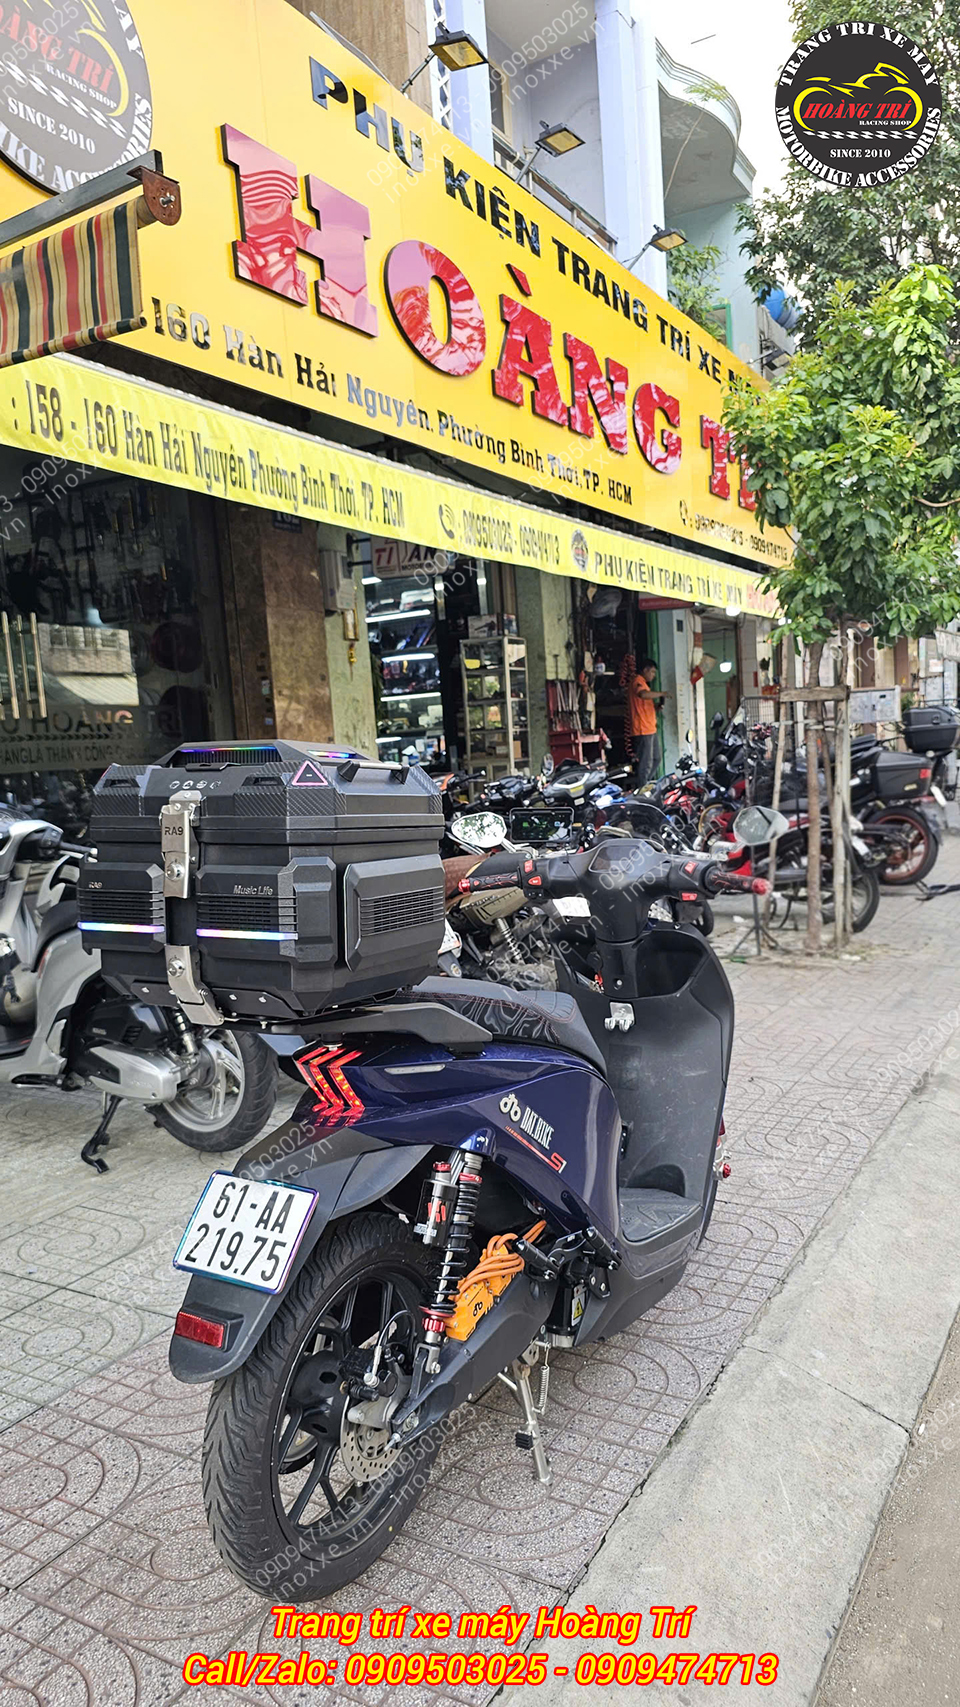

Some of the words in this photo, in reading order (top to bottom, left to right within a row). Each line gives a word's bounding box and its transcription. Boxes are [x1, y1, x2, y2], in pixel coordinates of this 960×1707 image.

[46, 63, 88, 93] RACING
[88, 86, 117, 109] SHOP
[67, 48, 115, 94] TRÍ
[8, 97, 57, 135] SINCE
[59, 124, 96, 154] 2010
[309, 56, 424, 177] PHỤ
[443, 156, 541, 259] KIỆN
[551, 236, 648, 333] TRANG
[656, 314, 691, 362] TRÍ
[697, 344, 721, 384] XE
[220, 123, 682, 475] HOÀNG
[151, 297, 211, 350] 160
[223, 325, 284, 378] Hàn
[294, 353, 337, 397] Hải
[437, 409, 506, 463] Phường
[510, 439, 544, 473] Bình
[608, 478, 633, 506] HCM
[25, 380, 64, 442] 158
[84, 398, 119, 457] 160
[122, 409, 158, 467] Hàn
[160, 421, 189, 475] Hải
[381, 487, 405, 529] HCM
[594, 551, 623, 583] PHỤ
[626, 558, 655, 588] KIỆN
[657, 568, 694, 594] TRANG
[164, 826, 184, 836] RA9
[233, 884, 257, 896] Music
[257, 886, 274, 897] Life
[519, 1105, 555, 1151] DAT.BIKE
[212, 1181, 296, 1234] 61-AA
[184, 1223, 287, 1282] 219.75
